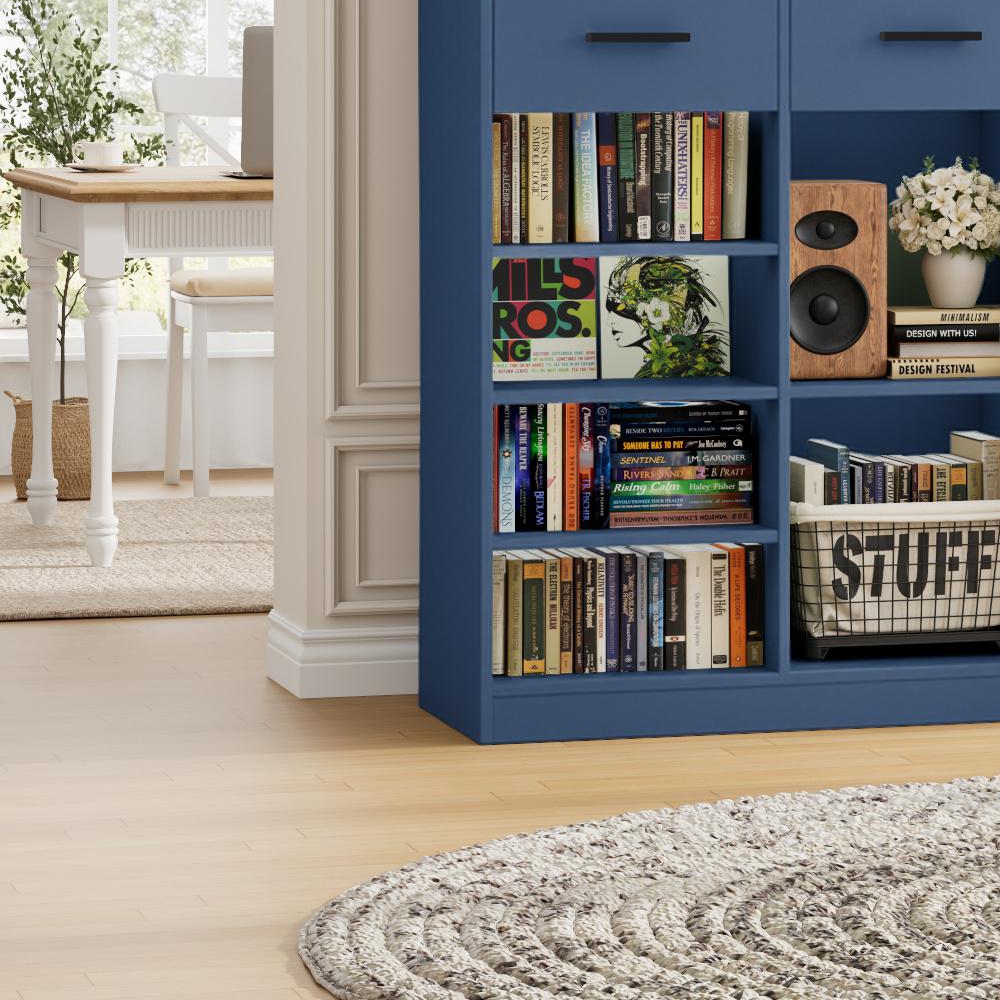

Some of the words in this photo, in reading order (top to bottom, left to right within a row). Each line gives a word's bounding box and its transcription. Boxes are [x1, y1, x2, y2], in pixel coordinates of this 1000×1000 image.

[581, 129, 591, 150] THE
[582, 153, 591, 176] IDEA
[639, 134, 647, 185] Bootstrapping
[582, 179, 592, 224] FACTORY
[940, 313, 990, 321] MINIMALISM
[963, 329, 976, 337] US!
[899, 365, 932, 375] DESIGN
[936, 364, 975, 374] FESTIVAL
[519, 407, 527, 431] BEWARE
[534, 403, 544, 424] Stacey
[535, 427, 545, 461] Livingston
[623, 442, 650, 450] SOMEONE
[651, 441, 662, 449] HAS
[665, 441, 672, 449] TO
[613, 482, 646, 495] Rising
[651, 482, 680, 491] Calm
[689, 482, 709, 491] Haley
[714, 482, 735, 490] Fisher
[501, 477, 513, 527] DEMONS
[534, 491, 544, 525] BEDLAM
[713, 566, 725, 577] The
[832, 530, 995, 600] STUFF
[713, 578, 726, 599] Double
[714, 602, 726, 616] Helix
